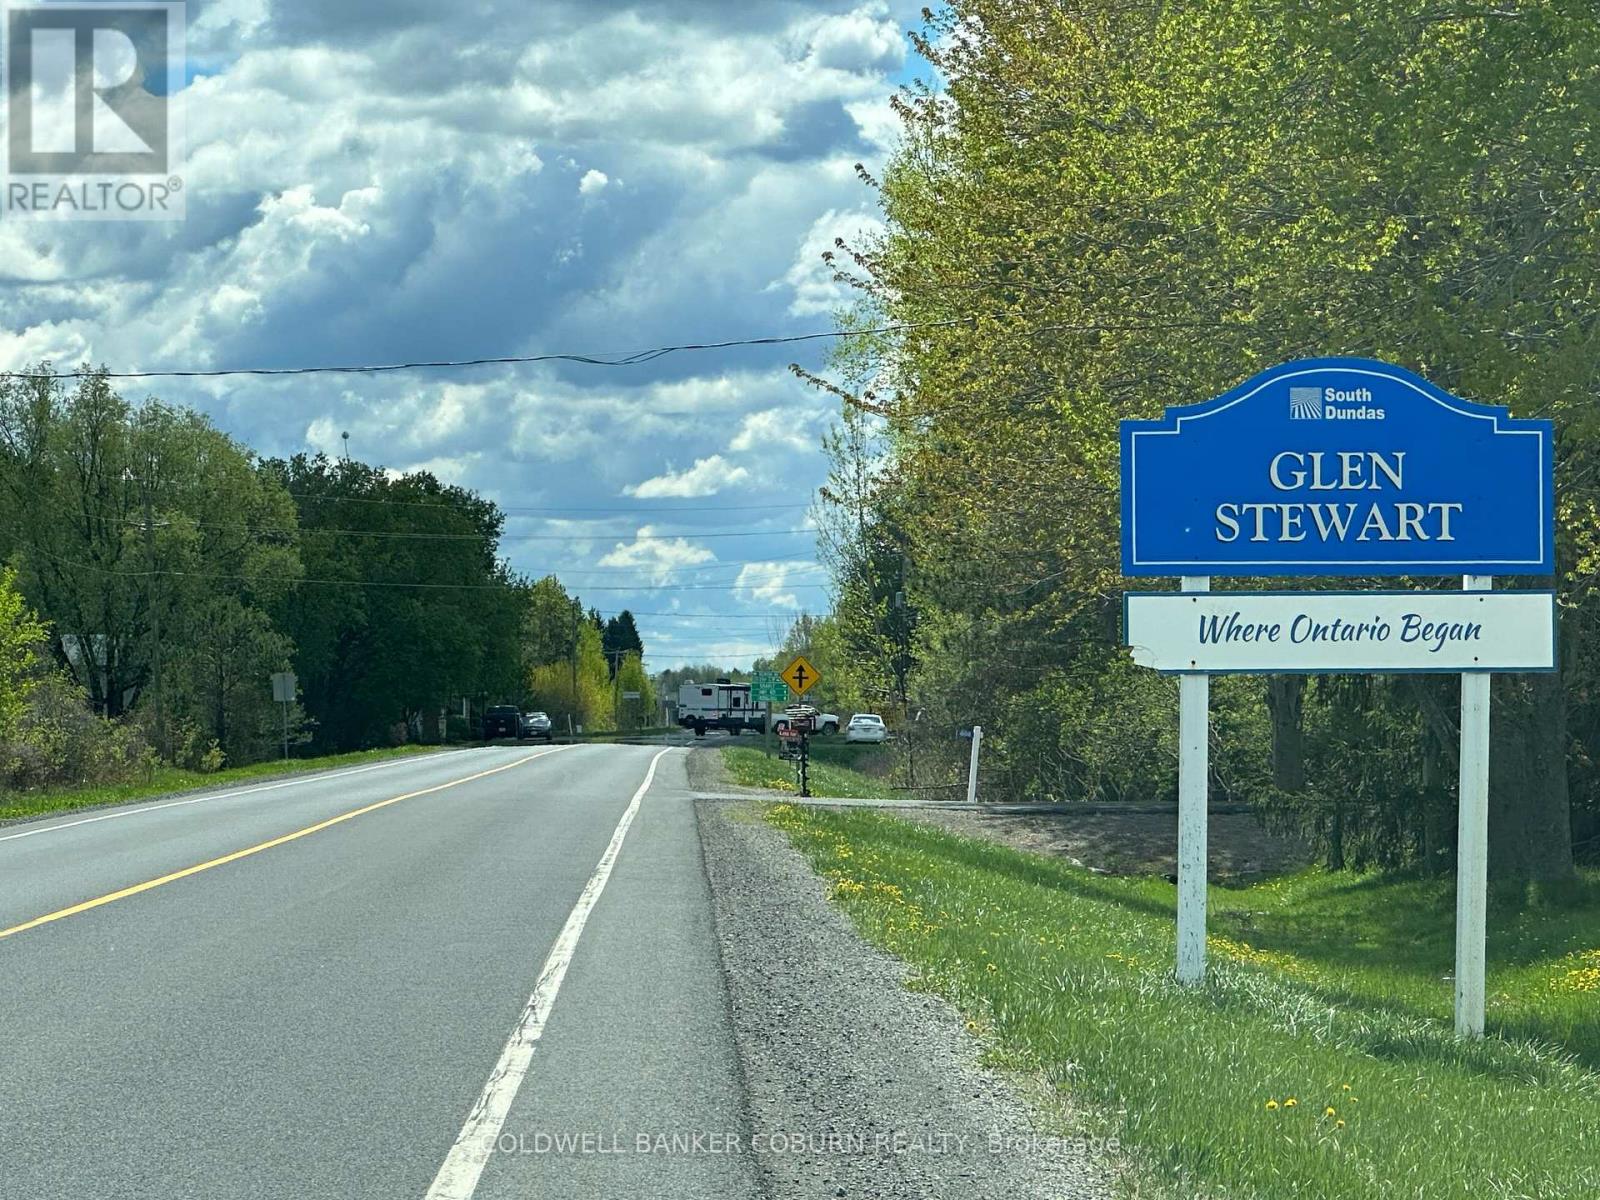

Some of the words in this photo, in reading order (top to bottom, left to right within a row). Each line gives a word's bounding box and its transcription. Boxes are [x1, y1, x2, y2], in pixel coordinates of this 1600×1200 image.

[1324, 387, 1372, 402] South
[1325, 405, 1386, 420] Dundas
[1269, 451, 1406, 491] GLEN
[1214, 502, 1463, 543] STEWART
[1199, 611, 1281, 644] Where
[1290, 614, 1390, 643] Ontario
[1399, 613, 1482, 652] Began
